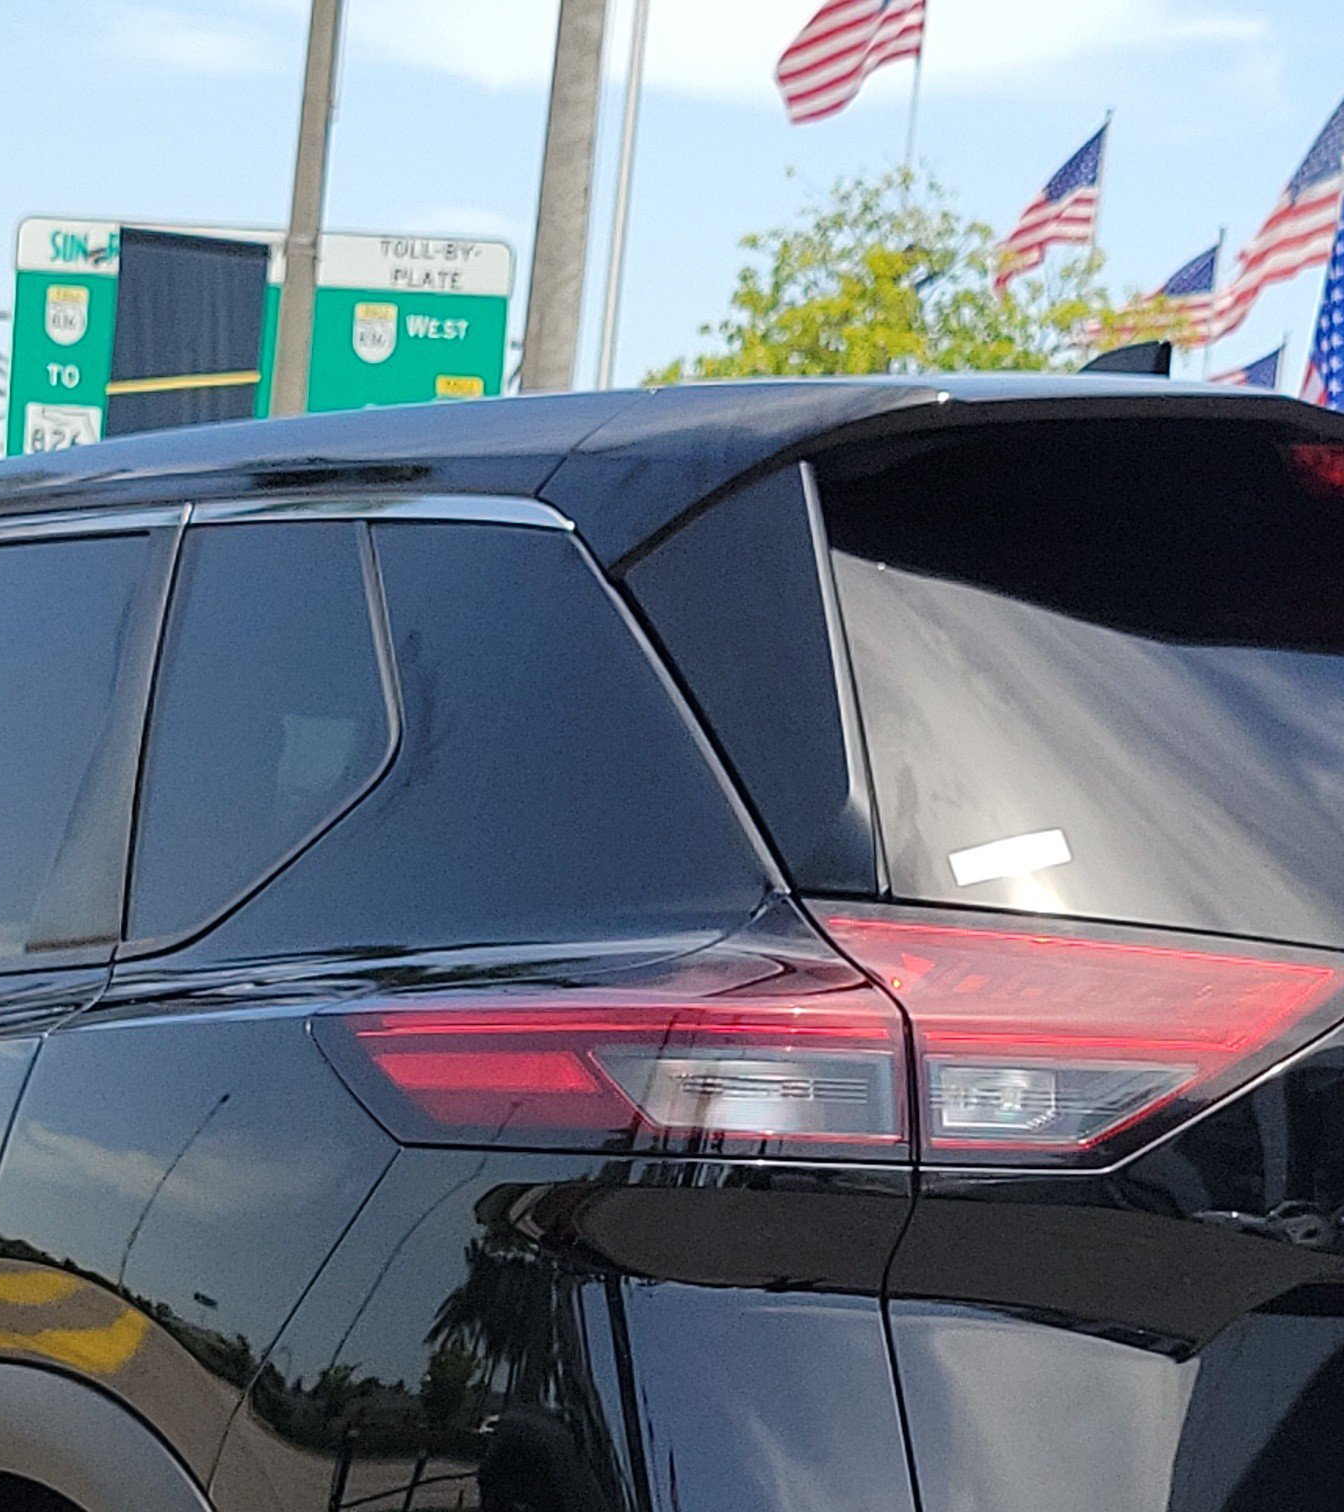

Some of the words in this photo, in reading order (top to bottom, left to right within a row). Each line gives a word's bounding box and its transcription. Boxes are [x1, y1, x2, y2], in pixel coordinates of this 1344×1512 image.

[391, 268, 462, 290] PLATE
[406, 314, 469, 341] WEST
[46, 362, 80, 389] TO
